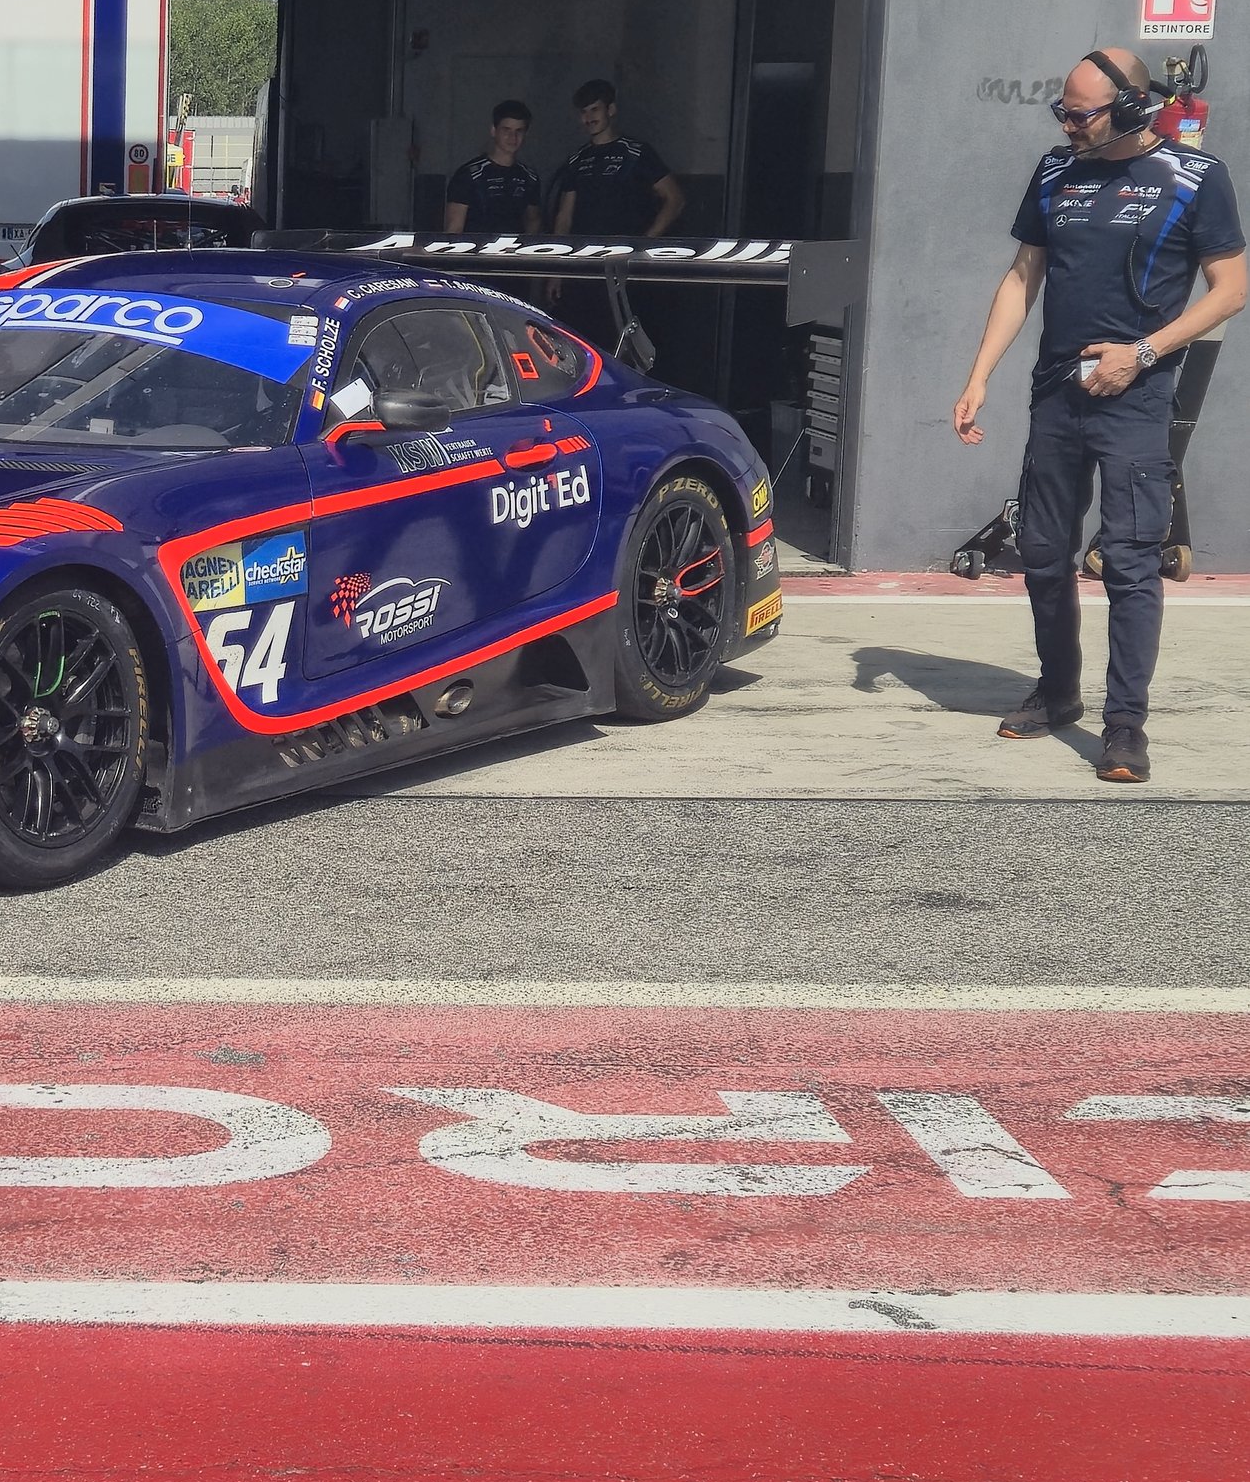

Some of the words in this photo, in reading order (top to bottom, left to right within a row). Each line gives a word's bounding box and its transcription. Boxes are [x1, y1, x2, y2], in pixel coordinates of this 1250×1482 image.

[1144, 24, 1210, 34] ESTINTORE
[134, 149, 145, 158] 80
[1120, 185, 1162, 194] AKM
[346, 234, 791, 264] Antonelli
[315, 317, 340, 377] SCHOLZE
[386, 437, 444, 474] KSW
[450, 450, 475, 462] SCHAFFT
[474, 447, 494, 458] WERTE
[659, 485, 670, 503] P
[673, 477, 718, 509] ZERO
[181, 555, 240, 581] AGNETI
[245, 556, 307, 582] checkstar
[184, 576, 240, 600] ARELLI
[356, 584, 442, 638] ROSSI
[380, 613, 434, 645] MOTORSPORT
[205, 600, 295, 705] 64
[128, 647, 148, 769] PIRELLI
